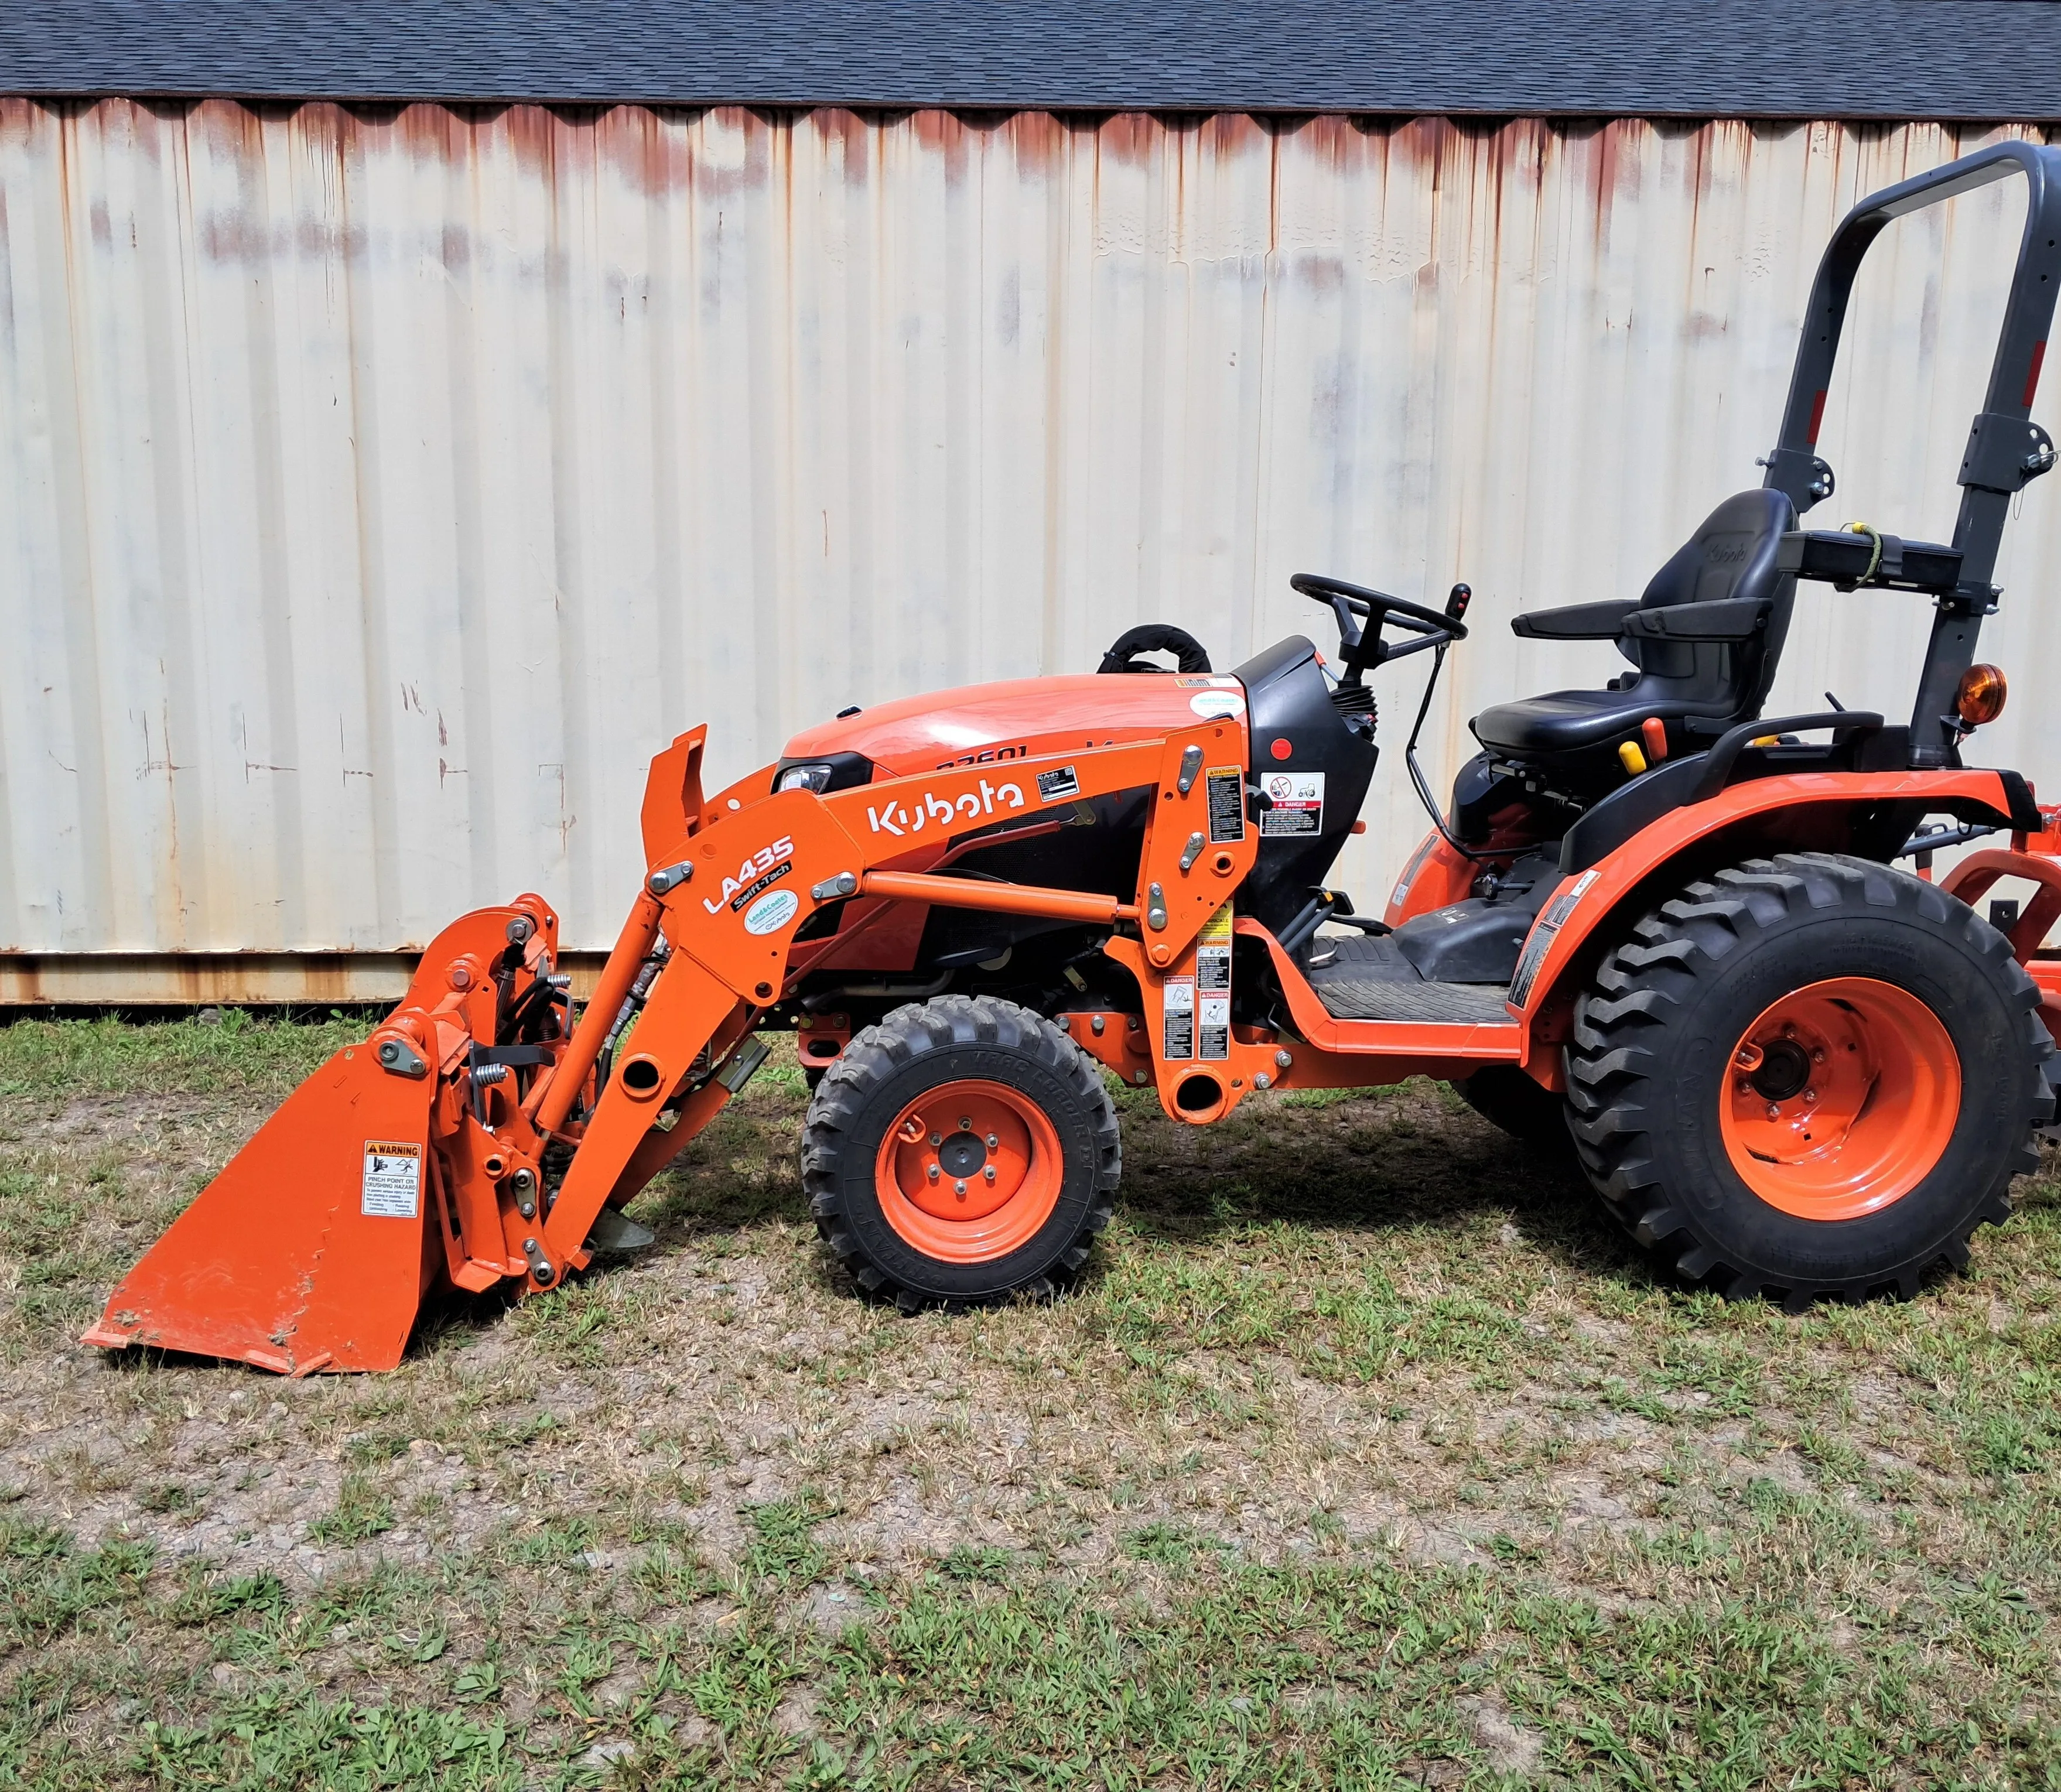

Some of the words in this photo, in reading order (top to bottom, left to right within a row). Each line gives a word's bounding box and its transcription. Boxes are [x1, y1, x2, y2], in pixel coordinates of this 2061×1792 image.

[867, 779, 1024, 836] Kubota
[703, 835, 794, 914] LA435
[734, 864, 789, 909] Swift-Tach
[748, 894, 788, 923] Land&Coates
[971, 1051, 1029, 1072] TRAC
[1033, 1071, 1090, 1138] LOADER
[378, 1144, 418, 1156] WARNING
[859, 1218, 929, 1283] TITAN
